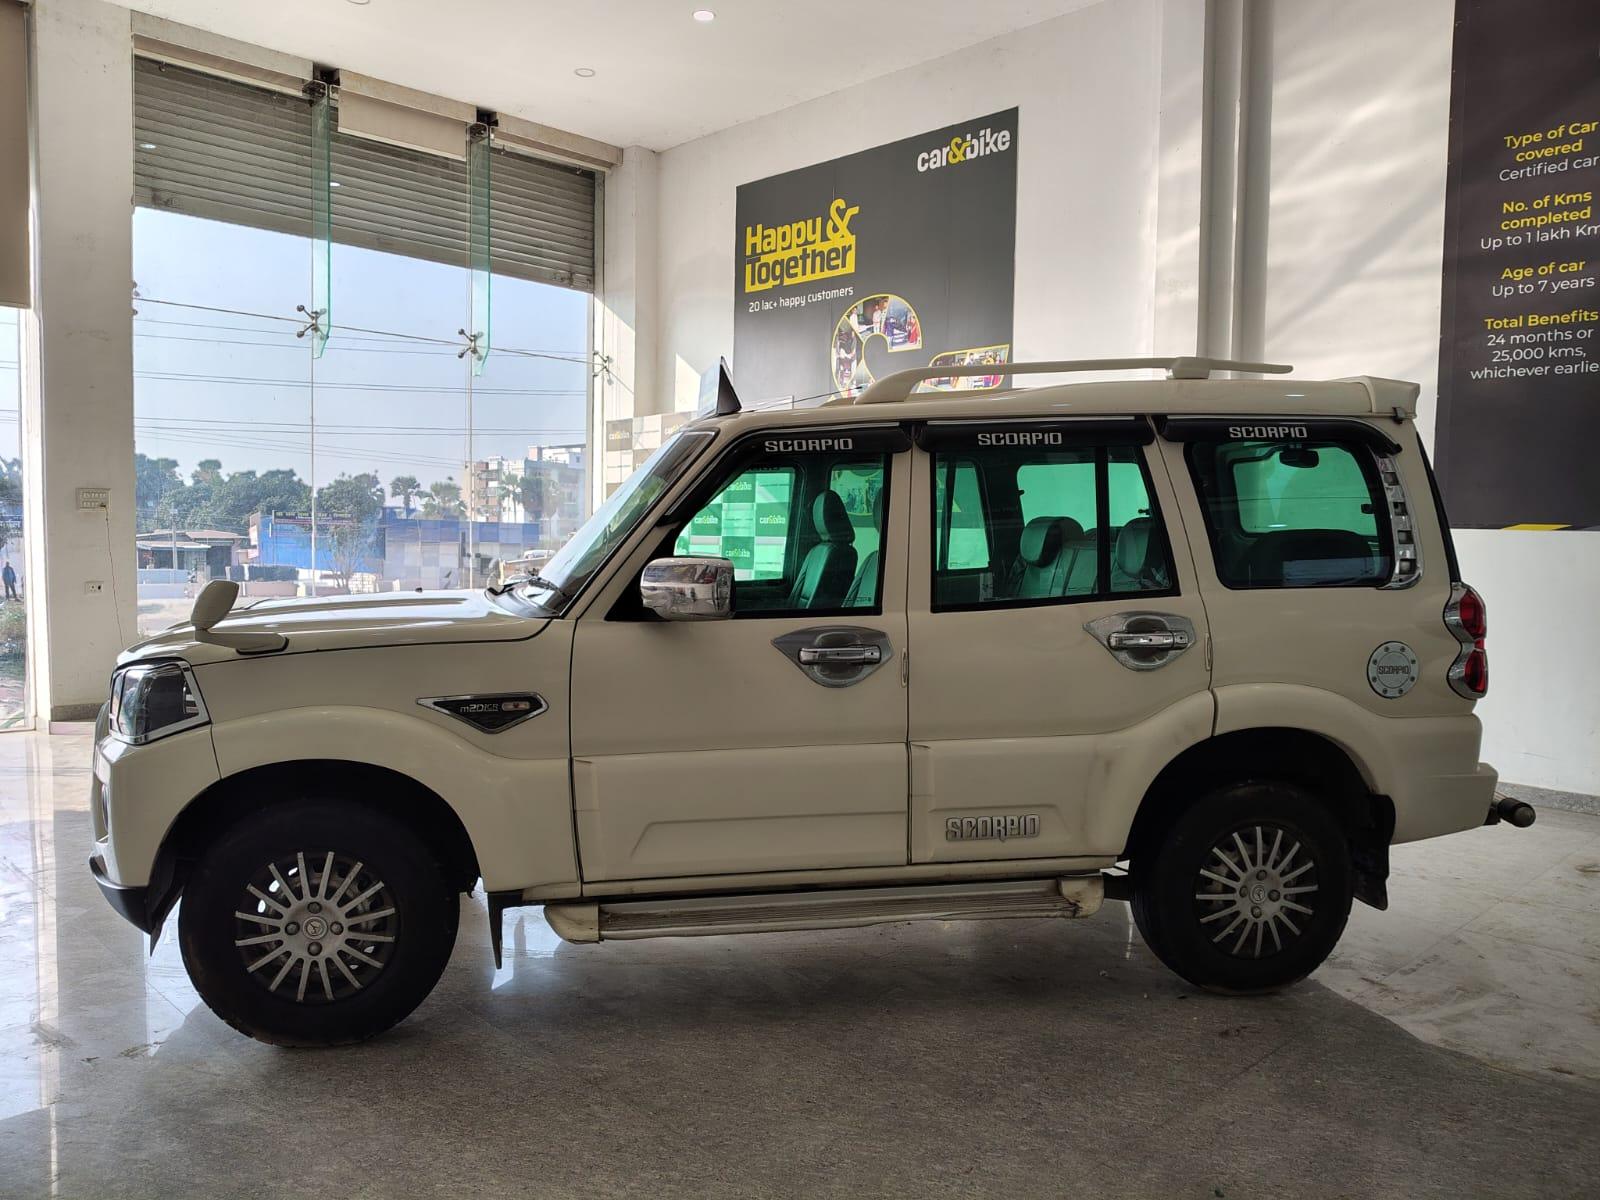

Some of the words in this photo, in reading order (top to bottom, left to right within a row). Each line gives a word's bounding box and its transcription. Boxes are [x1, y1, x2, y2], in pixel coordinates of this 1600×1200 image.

[1504, 132, 1543, 149] Type
[1547, 125, 1565, 139] of
[1568, 121, 1599, 135] Car
[917, 128, 1011, 172] car&bike
[1516, 139, 1583, 162] covered
[1499, 158, 1568, 181] Certified
[1503, 201, 1528, 214] No.
[1533, 195, 1550, 209] of
[1554, 191, 1592, 206] Kms
[745, 215, 822, 256] Happy
[826, 198, 860, 241] &
[1501, 206, 1591, 230] completed
[1480, 235, 1502, 250] Up
[1506, 235, 1522, 246] to
[1526, 231, 1531, 243] 1
[1536, 226, 1570, 242] lakh
[746, 243, 852, 287] Together
[1500, 265, 1533, 281] Age
[1537, 262, 1555, 275] of
[1558, 260, 1585, 273] car
[1492, 285, 1514, 298] Up
[1517, 282, 1534, 294] to
[1538, 280, 1548, 292] 7
[1551, 276, 1595, 294] years
[749, 301, 761, 313] 20
[762, 299, 777, 311] lac+
[780, 296, 806, 309] happy
[807, 287, 854, 302] customers
[1484, 316, 1523, 330] Total
[1528, 309, 1599, 326] Benefits
[1487, 333, 1506, 346] 24
[1510, 328, 1573, 344] months
[1576, 328, 1594, 340] or
[1492, 348, 1544, 363] 25,000
[1548, 346, 1587, 358] kms,
[1470, 365, 1550, 380] whichever
[978, 432, 1062, 446] SCORPIO
[1229, 426, 1308, 438] SCORPIO
[765, 438, 853, 452] SCORPIO
[945, 814, 1041, 843] SCORPIO
